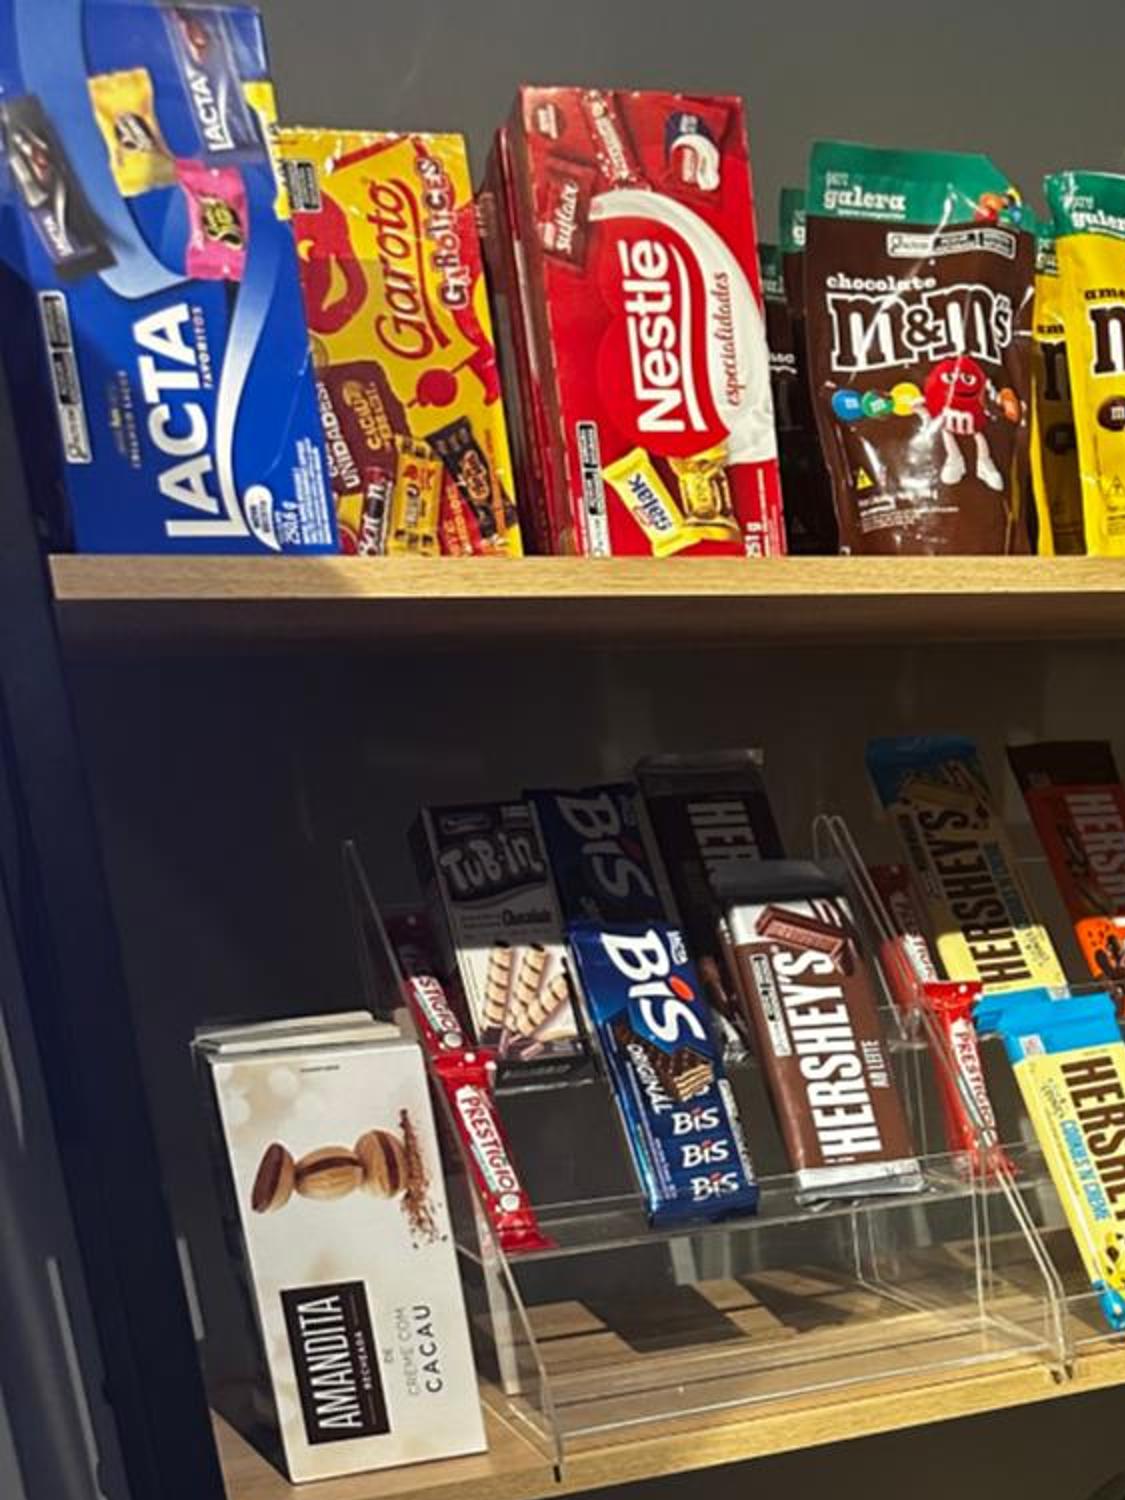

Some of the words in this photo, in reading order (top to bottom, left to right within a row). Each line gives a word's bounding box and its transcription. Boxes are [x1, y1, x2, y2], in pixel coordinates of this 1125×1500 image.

[193, 72, 234, 152] LACTA
[824, 185, 907, 211] galera
[375, 178, 434, 360] Garoto
[826, 272, 937, 292] chocolate
[711, 270, 743, 407] especialidades
[134, 303, 250, 538] LACTA
[773, 948, 884, 1154] HERSHEY'S
[460, 1092, 517, 1195] PRESTIGIO
[299, 1292, 364, 1430] AMANDITA
[357, 1329, 374, 1392] RECHEADA
[424, 1303, 444, 1395] CACAU
